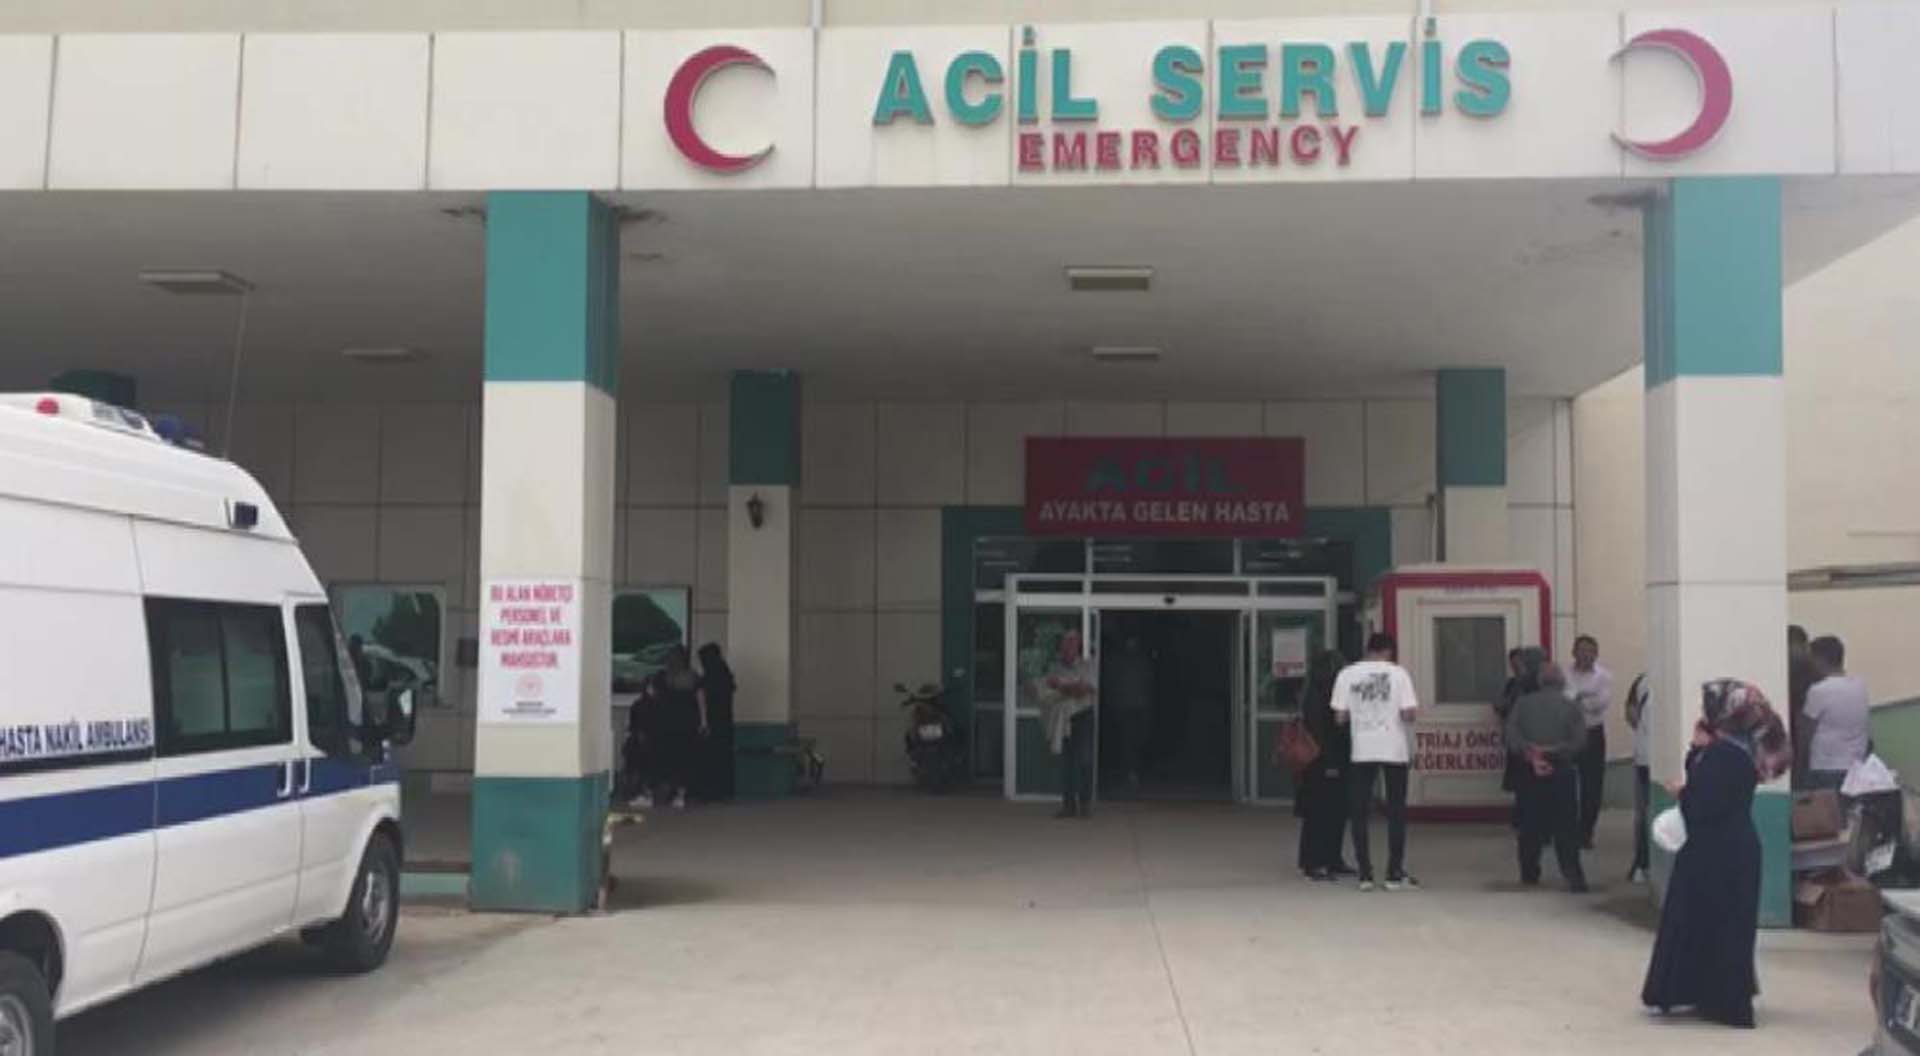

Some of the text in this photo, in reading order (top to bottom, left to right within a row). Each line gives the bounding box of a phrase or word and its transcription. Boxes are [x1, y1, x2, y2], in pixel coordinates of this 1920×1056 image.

[872, 18, 1513, 126] ACİL SERVİS
[1017, 125, 1359, 173] EMERGENCY
[1085, 450, 1248, 492] ACİL
[1039, 500, 1289, 522] AYAKTA GELEN HASTA
[1416, 730, 1504, 748] TRİAJ ÖNC
